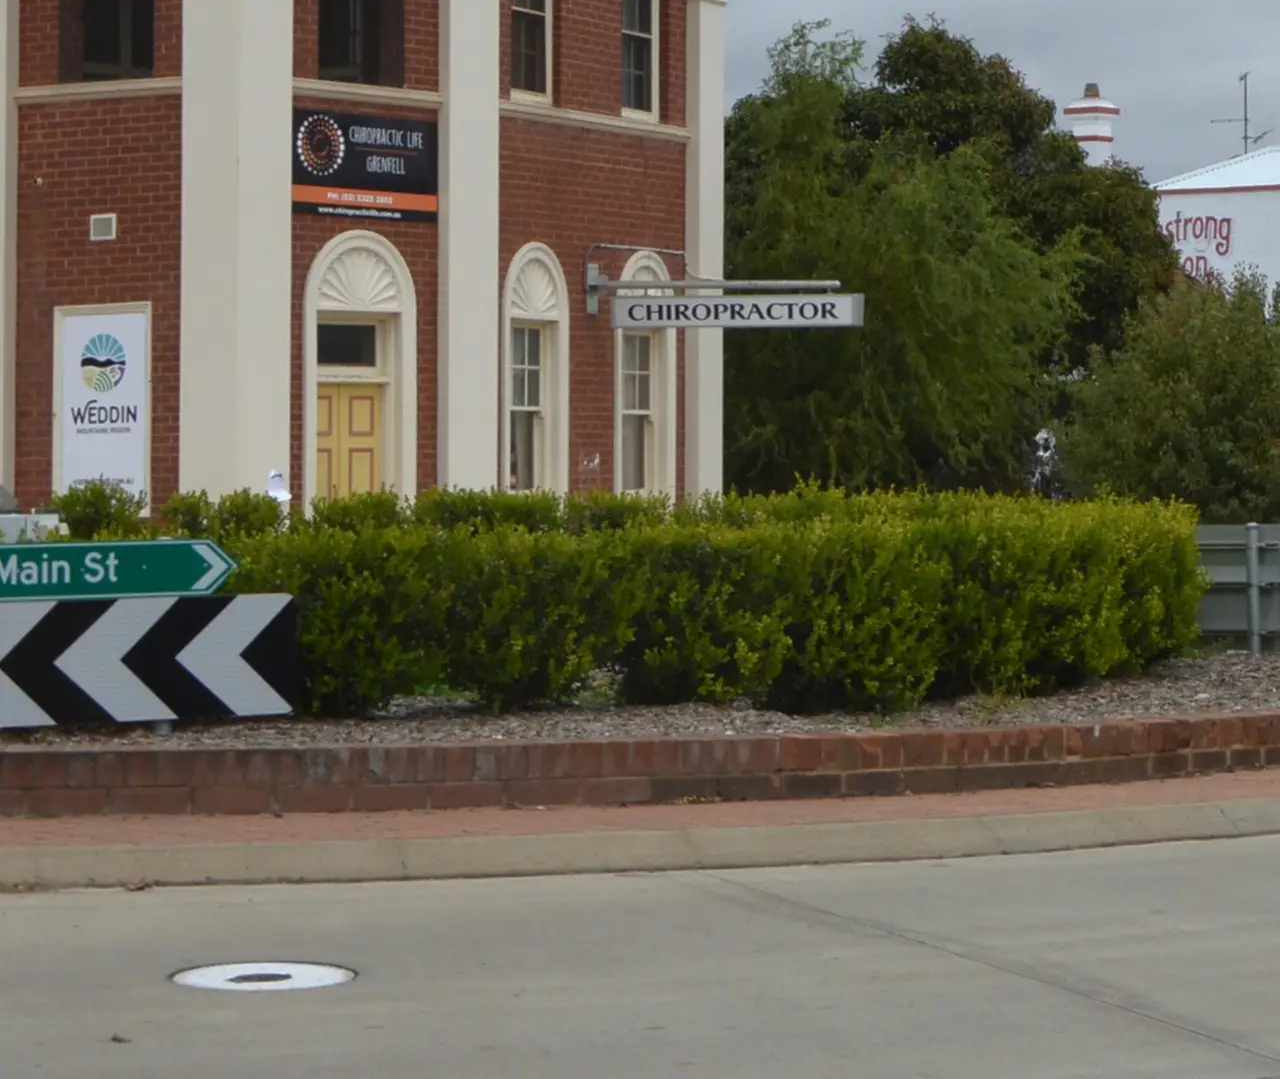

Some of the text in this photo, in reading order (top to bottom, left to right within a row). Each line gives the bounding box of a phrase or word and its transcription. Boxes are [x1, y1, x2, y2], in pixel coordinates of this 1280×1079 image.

[349, 125, 424, 150] CHIROPRACTIC LIFE
[366, 155, 406, 175] GRENFELL
[627, 301, 839, 322] CHIROPRACTOR
[70, 399, 138, 425] WEDDIN
[0, 551, 120, 586] Main St
